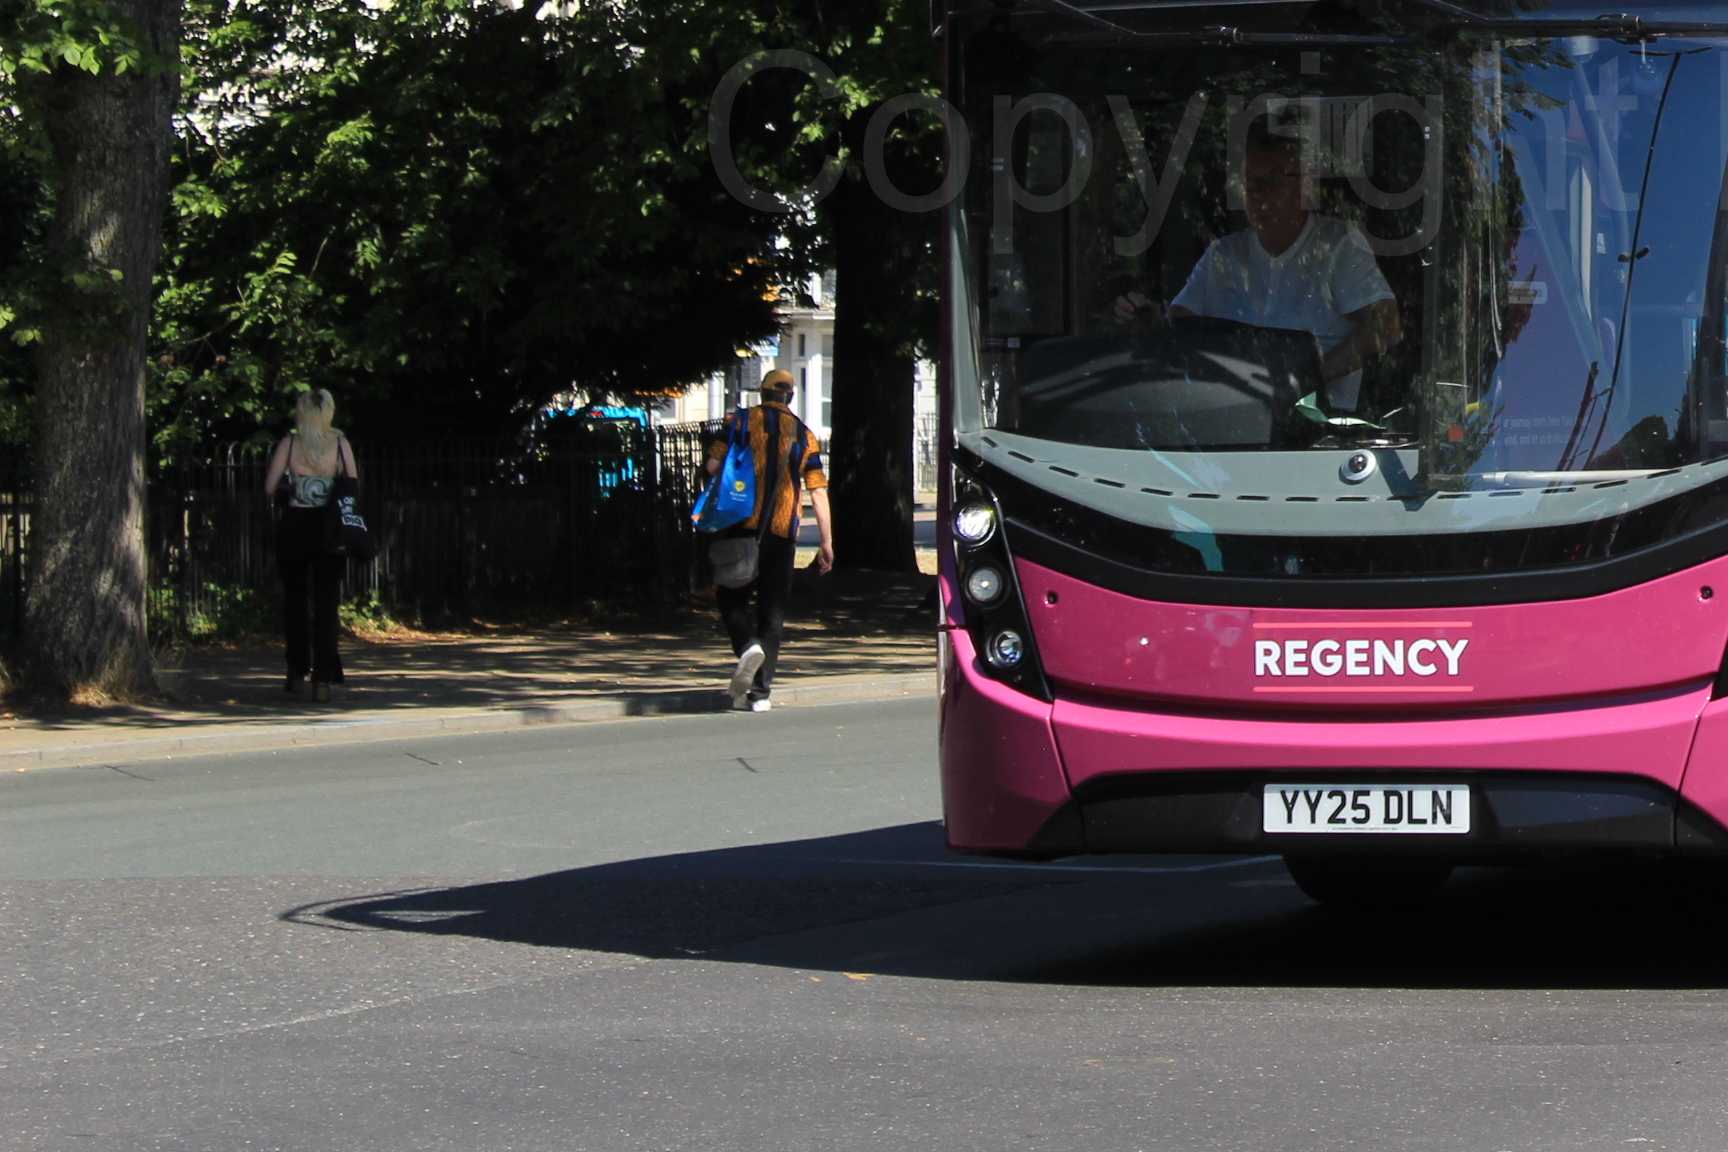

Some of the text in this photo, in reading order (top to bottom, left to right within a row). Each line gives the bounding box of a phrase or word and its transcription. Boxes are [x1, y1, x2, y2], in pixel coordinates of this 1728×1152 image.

[1254, 639, 1469, 676] REGENCY
[1280, 789, 1453, 825] YY25 DLN
